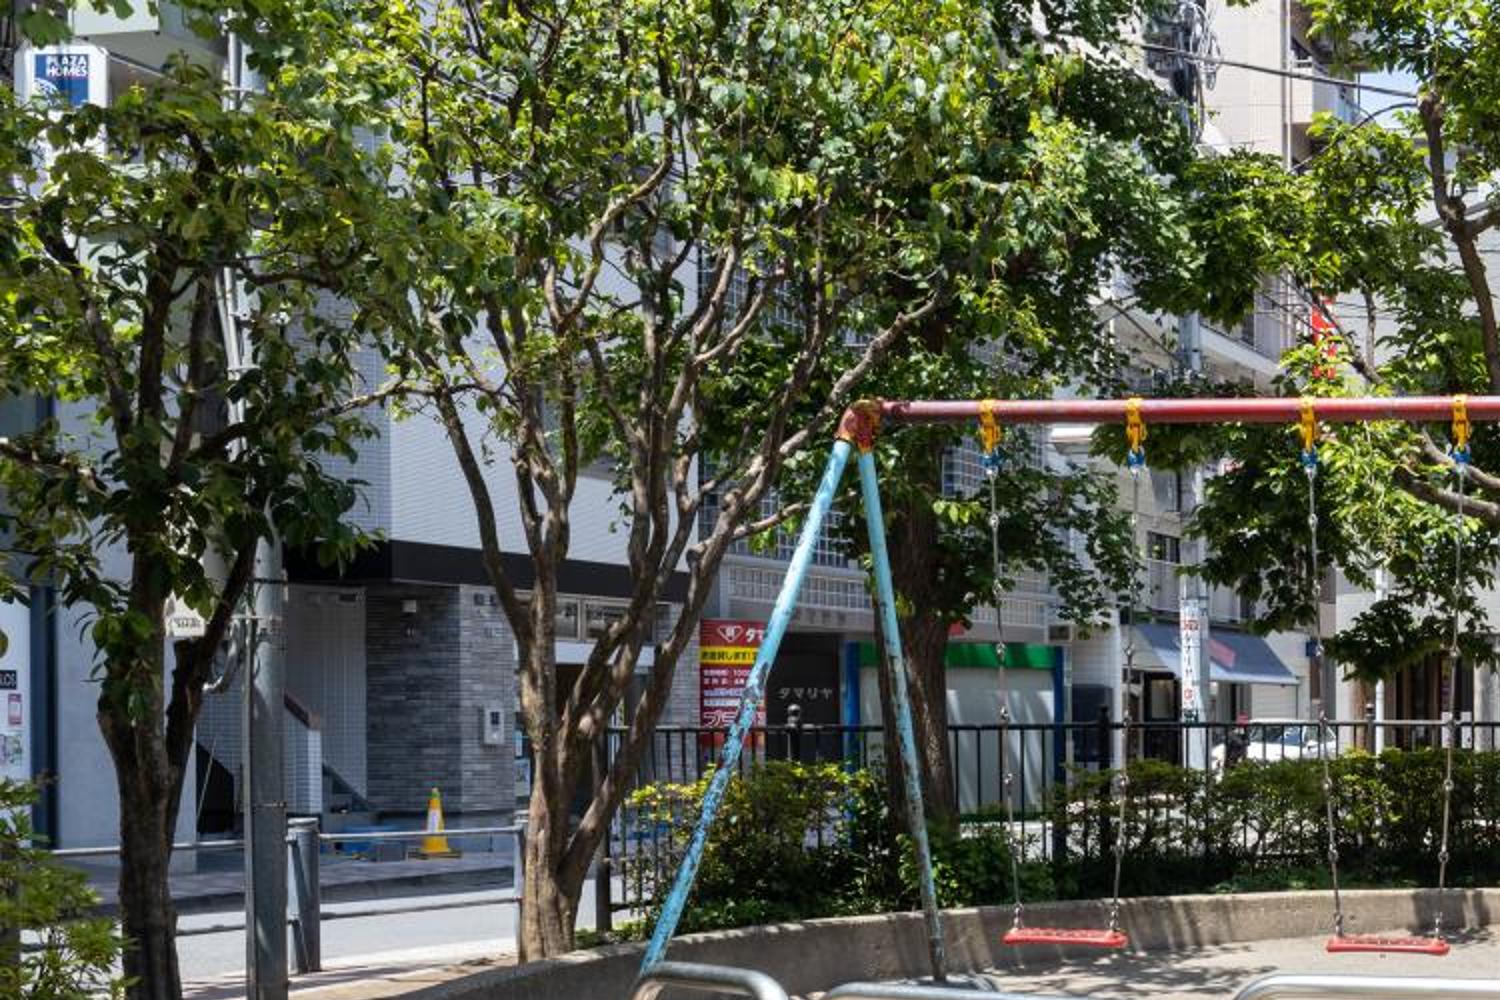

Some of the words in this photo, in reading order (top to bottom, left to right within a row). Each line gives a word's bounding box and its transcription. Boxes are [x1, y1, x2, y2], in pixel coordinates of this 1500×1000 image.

[46, 55, 87, 65] PLAZA
[46, 65, 88, 77] HOMES
[779, 687, 832, 699] タマリヤ
